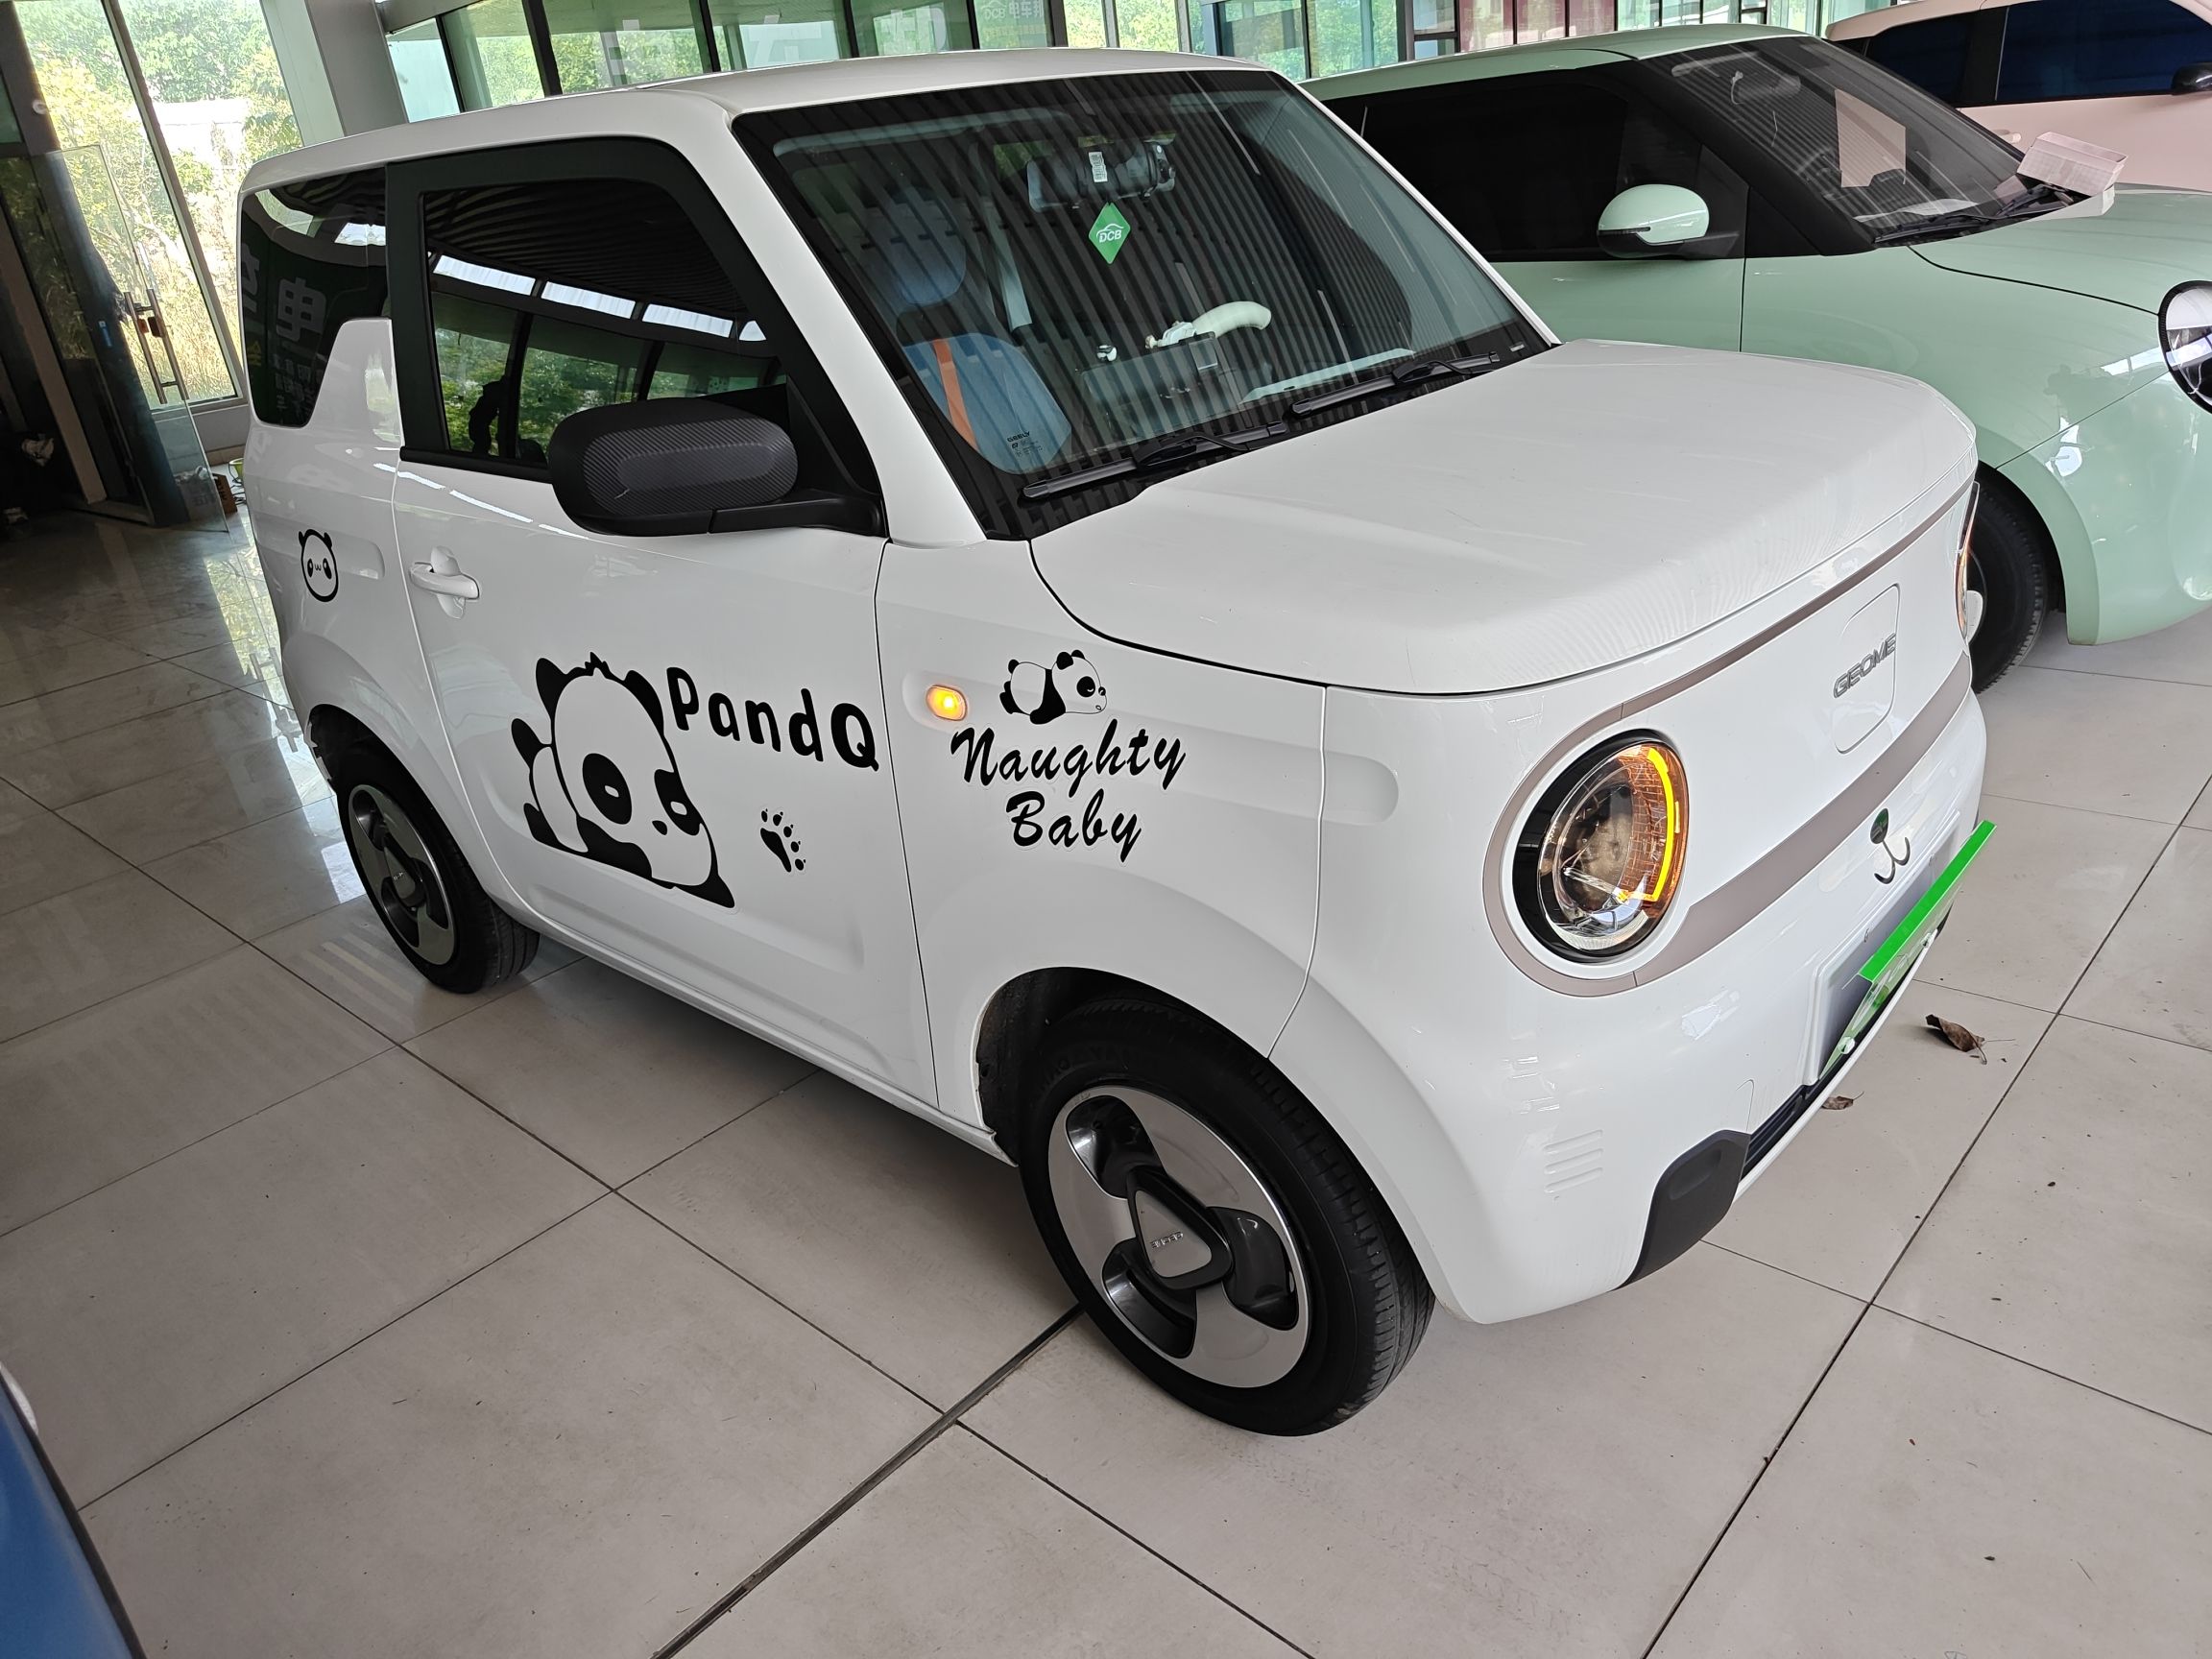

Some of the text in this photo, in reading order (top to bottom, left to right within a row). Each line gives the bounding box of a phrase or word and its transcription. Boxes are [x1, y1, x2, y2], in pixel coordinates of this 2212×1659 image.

[1098, 229, 1122, 243] DCB
[1833, 633, 1897, 698] GEOME
[950, 718, 1187, 799] Naughty
[1005, 787, 1142, 863] Baby
